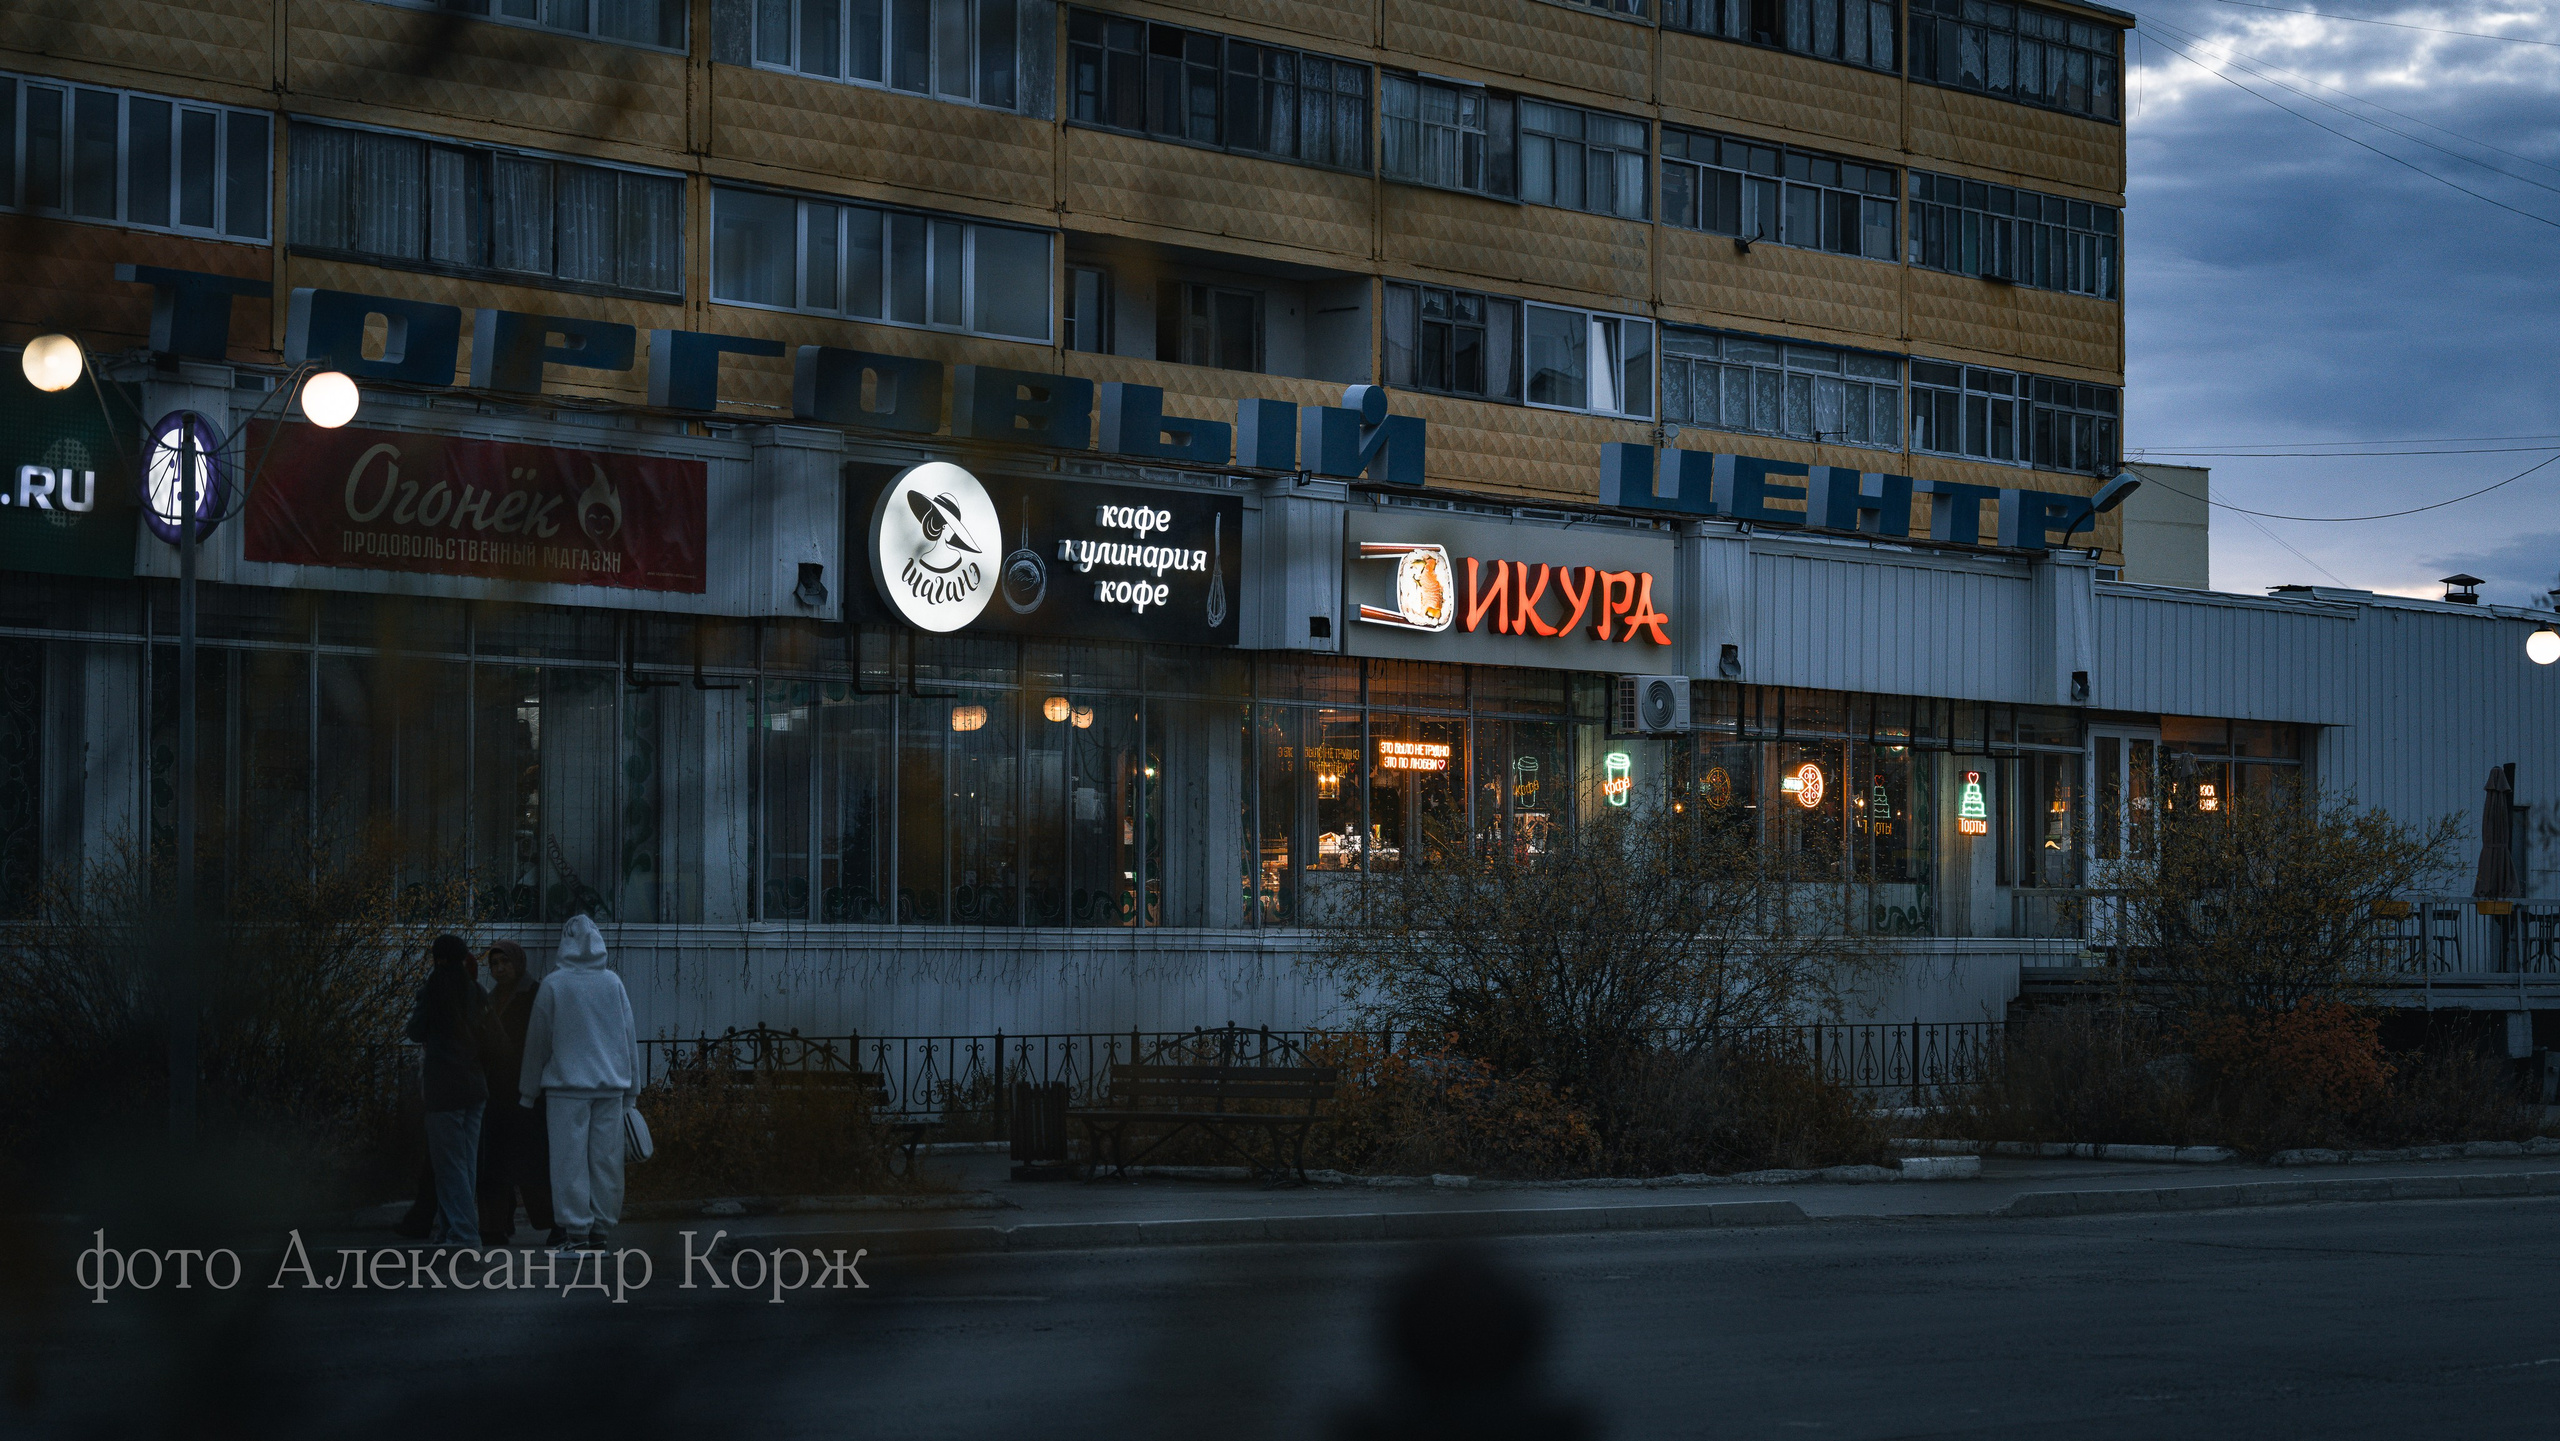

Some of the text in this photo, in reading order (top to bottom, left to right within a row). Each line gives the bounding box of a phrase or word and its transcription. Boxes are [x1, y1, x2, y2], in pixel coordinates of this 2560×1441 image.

[115, 262, 2095, 550] ТОРГОВЫЙ ЦЕНТР
[344, 442, 564, 538] Огонёк
[1098, 505, 1171, 539] кафе
[343, 531, 621, 573] ПРОДОВОЛЬСТВЕННЫЙ МАГАЗИН
[1060, 539, 1207, 577] кулинария
[1097, 580, 1169, 614] кофе
[1458, 555, 1672, 646] ИКУРА
[1380, 741, 1393, 754] ЭТО
[1384, 756, 1397, 768] ЭТО
[1410, 757, 1437, 771] ЛЮБВИ
[1958, 817, 1987, 836] Торты
